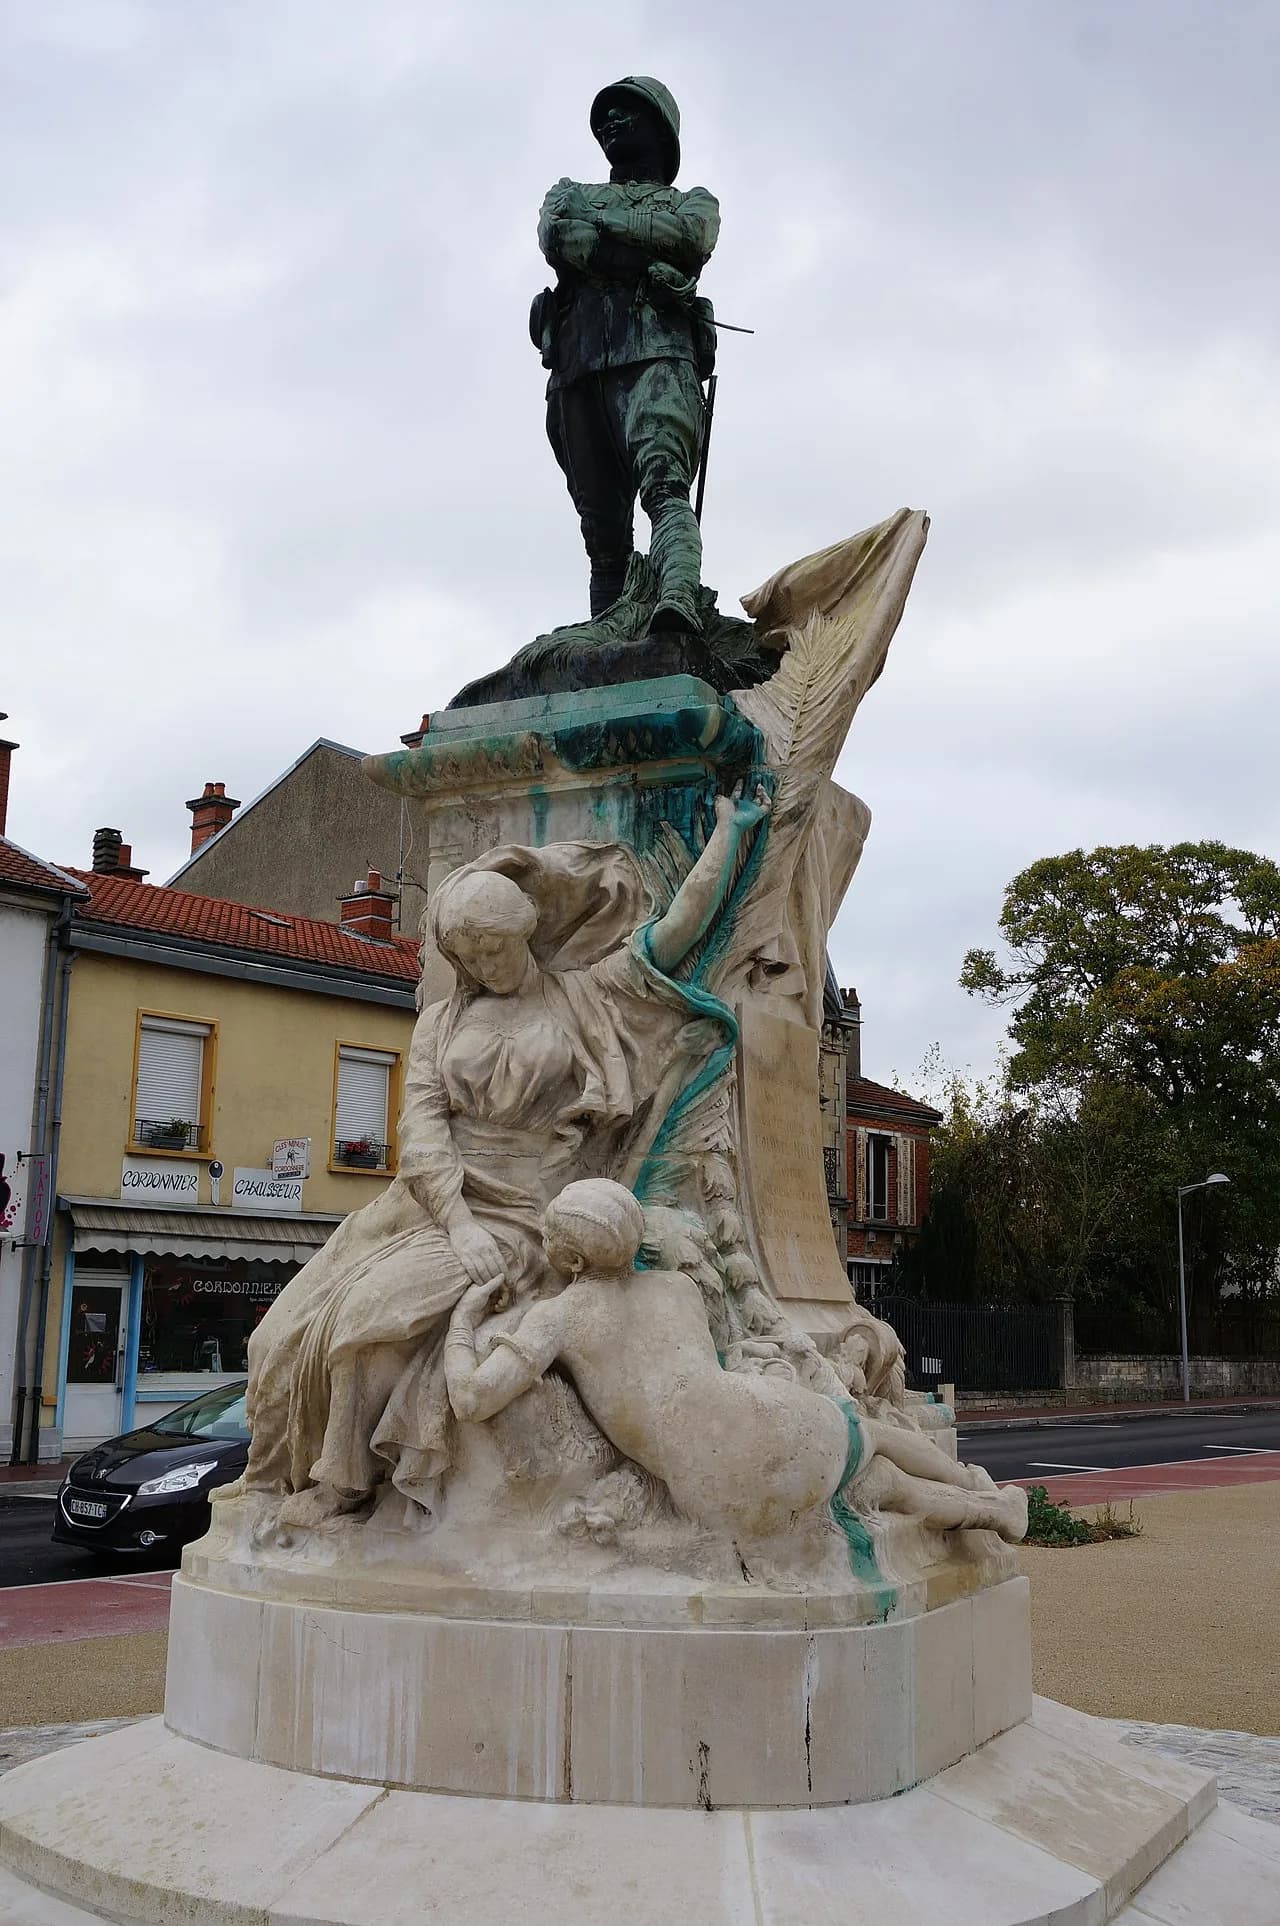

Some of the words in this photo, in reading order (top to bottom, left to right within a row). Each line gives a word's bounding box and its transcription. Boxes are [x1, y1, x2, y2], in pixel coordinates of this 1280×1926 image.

[122, 1170, 198, 1192] CORDONNIER
[234, 1179, 301, 1201] CHAUSSEUR
[33, 1160, 45, 1240] TATOO
[193, 1280, 282, 1295] CORDONNIER
